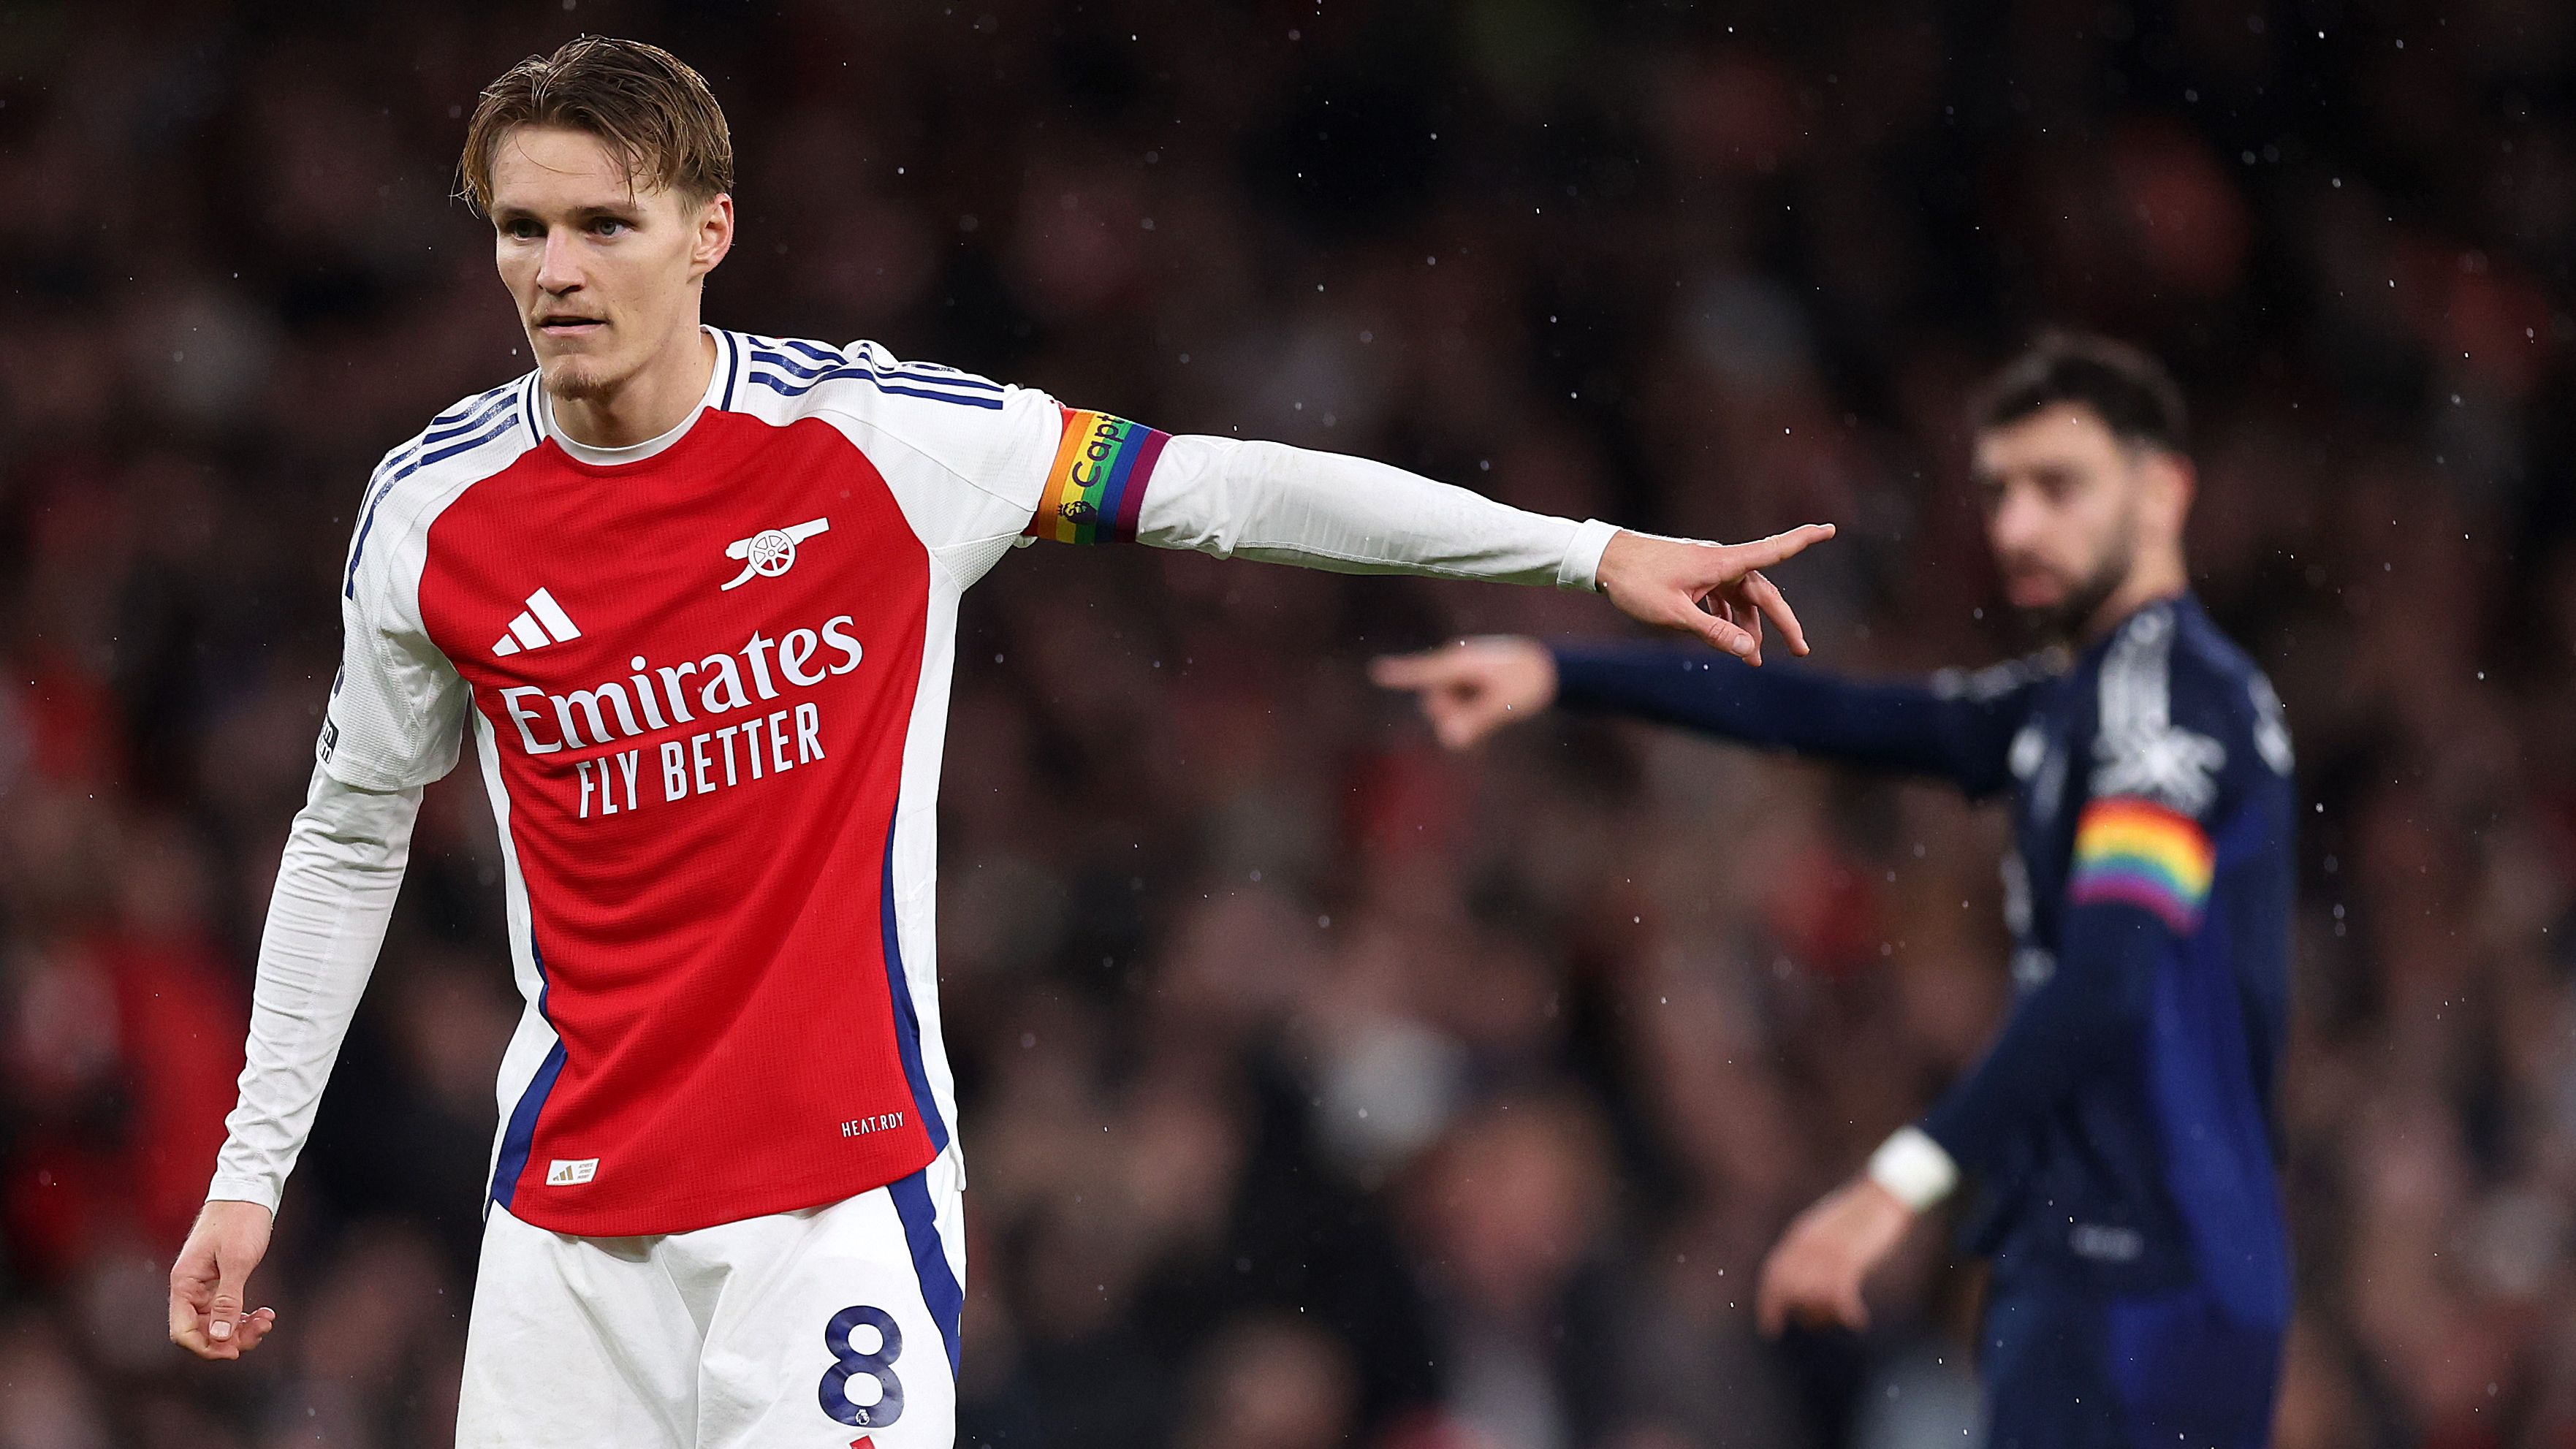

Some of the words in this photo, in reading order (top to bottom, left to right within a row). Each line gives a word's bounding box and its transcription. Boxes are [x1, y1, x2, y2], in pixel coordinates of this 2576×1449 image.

[499, 615, 863, 754] Emirates
[575, 750, 639, 818] FLY
[661, 702, 826, 802] BETTER
[841, 1111, 904, 1138] HEAT.RDY
[818, 1305, 905, 1428] 8
